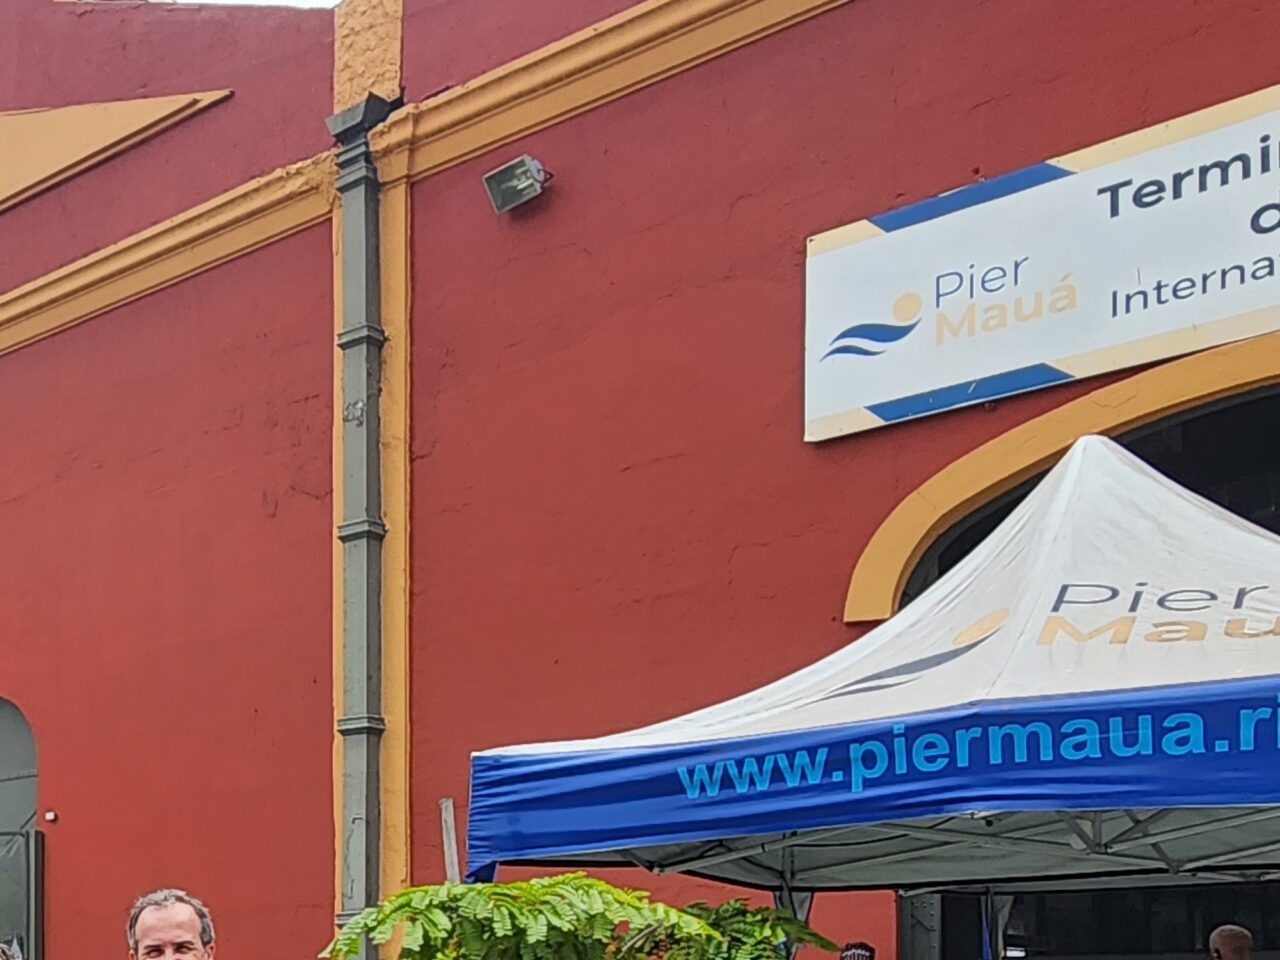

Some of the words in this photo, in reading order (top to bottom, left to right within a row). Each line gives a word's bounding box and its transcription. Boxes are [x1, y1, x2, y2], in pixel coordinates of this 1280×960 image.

[1096, 134, 1280, 219] Termi
[935, 256, 1029, 309] Pier
[935, 272, 1078, 348] Mauá
[1111, 253, 1280, 319] Interna
[1050, 582, 1269, 613] Pier
[677, 692, 1280, 798] www.piermaua.r
